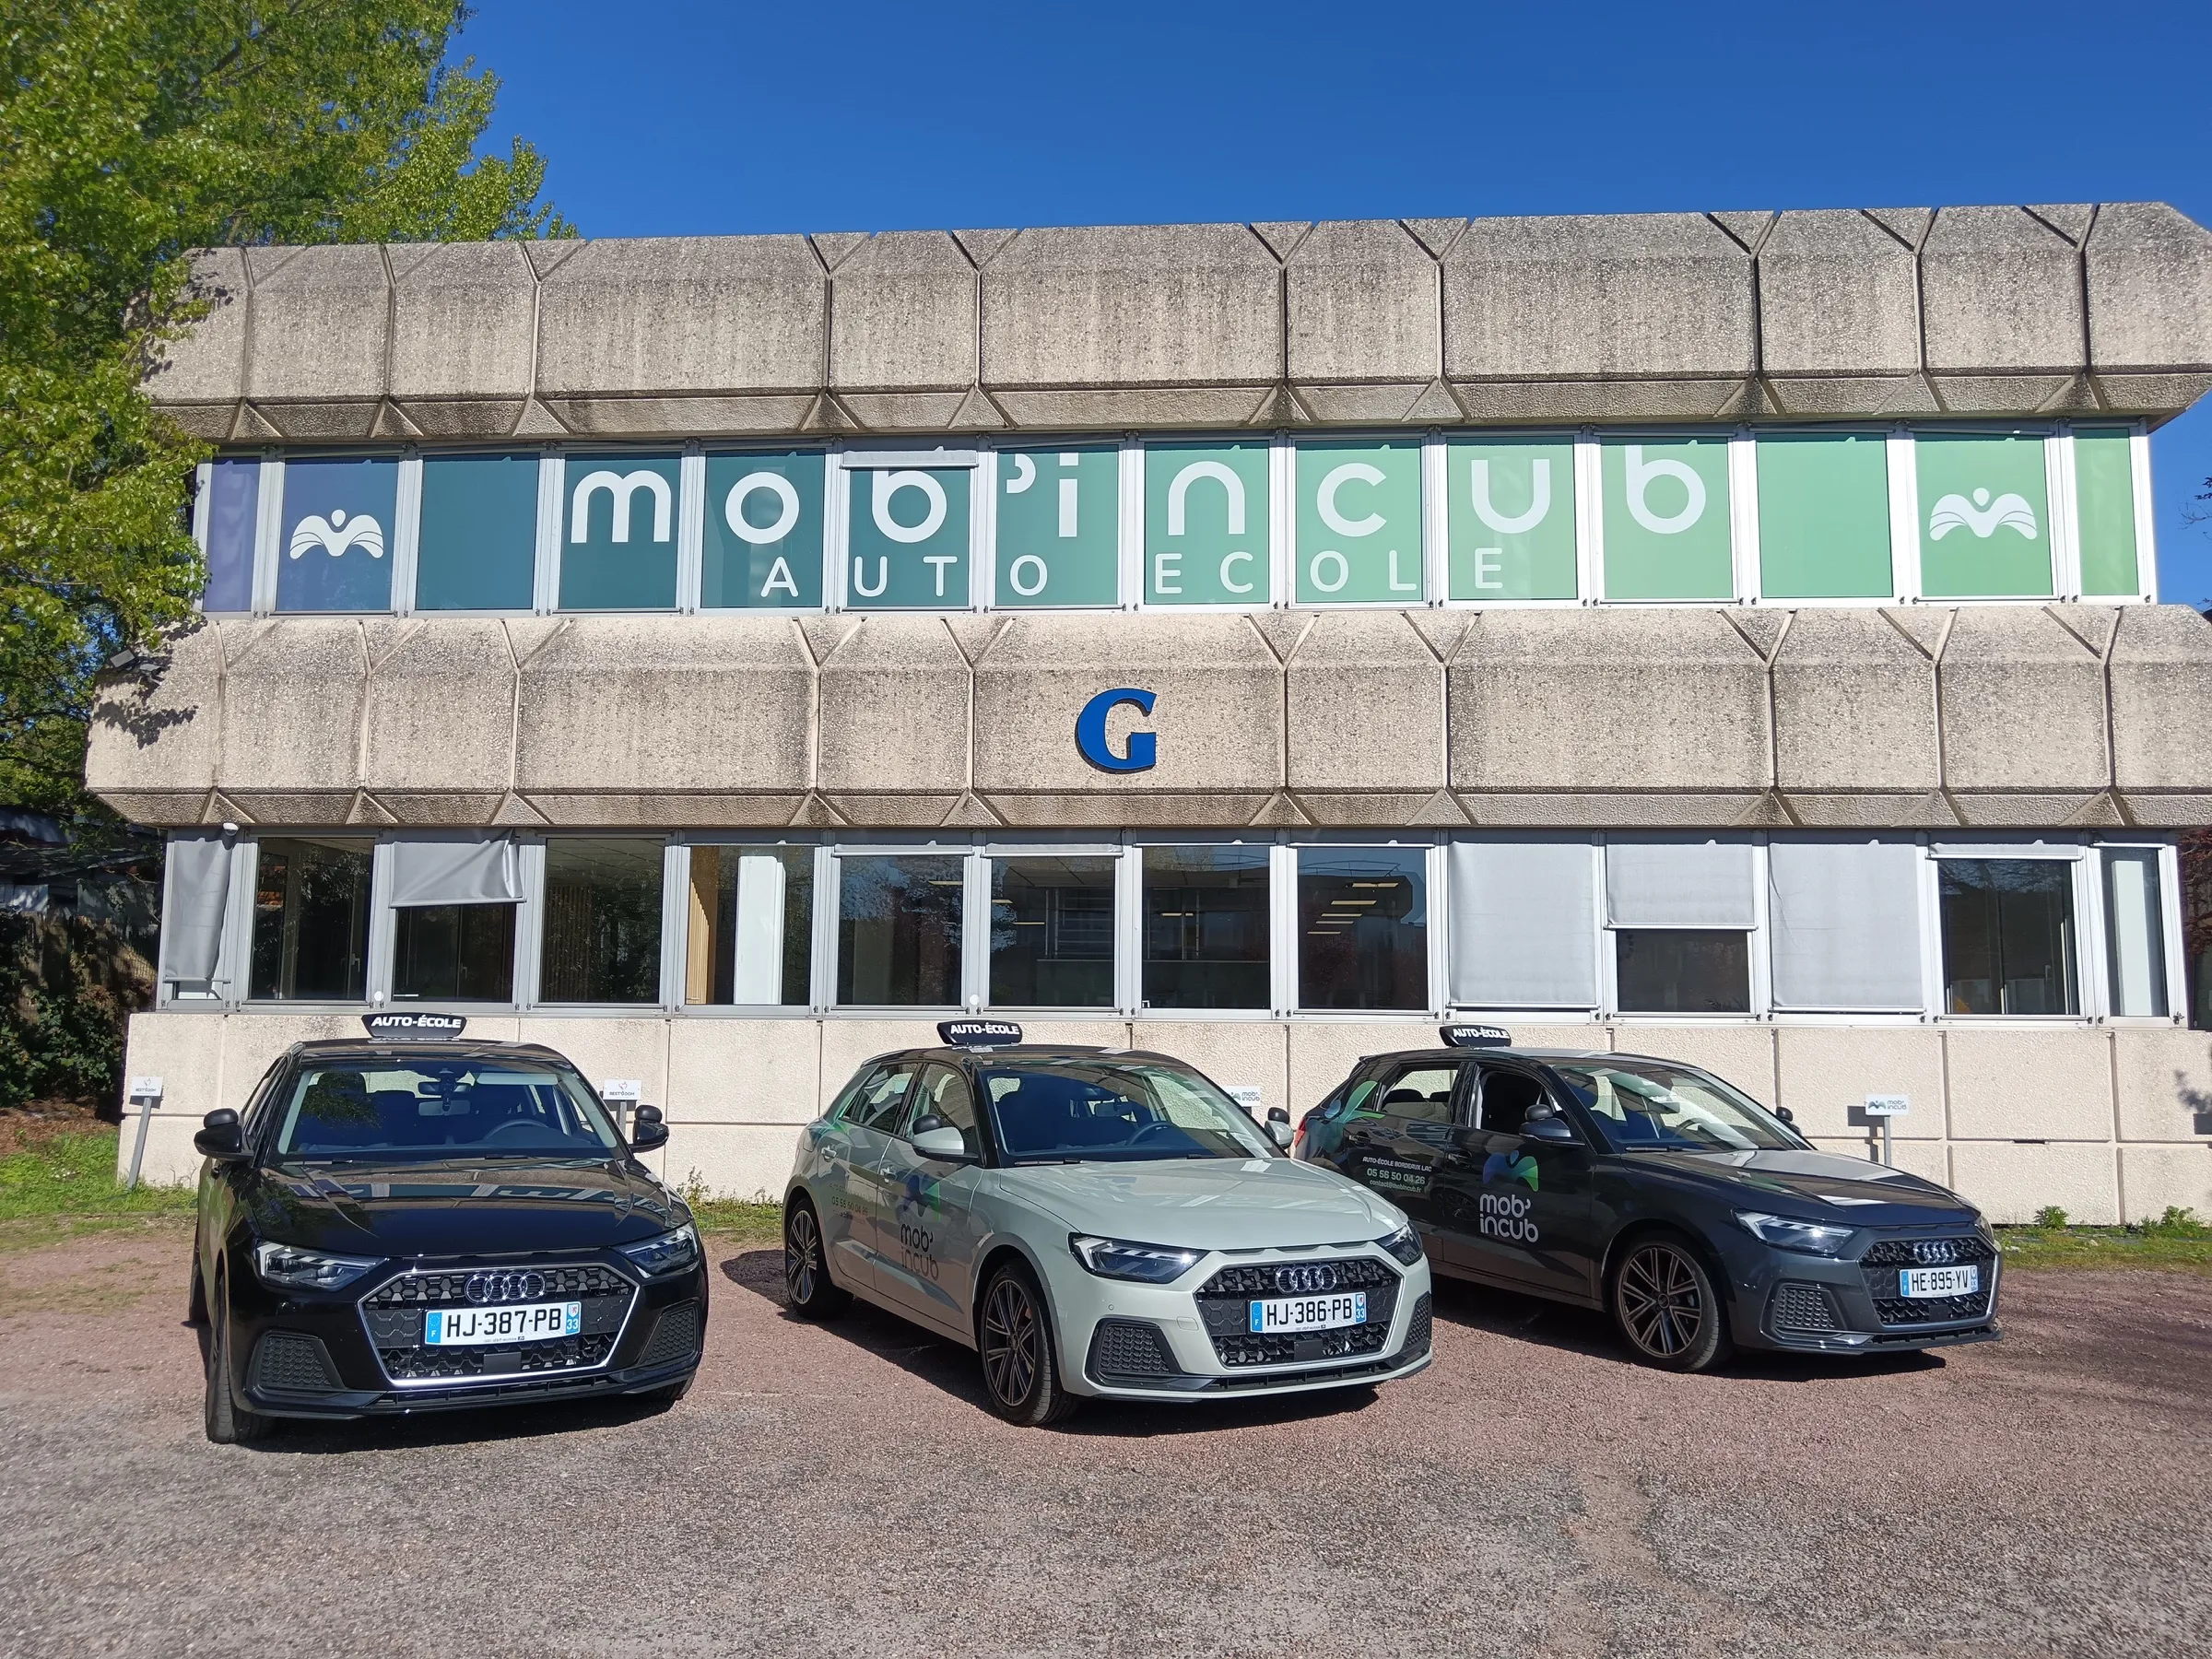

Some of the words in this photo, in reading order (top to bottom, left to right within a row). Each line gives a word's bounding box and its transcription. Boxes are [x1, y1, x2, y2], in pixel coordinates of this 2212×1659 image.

[759, 554, 1048, 597] AUTO
[1154, 547, 1503, 595] ECOLE
[1075, 687, 1158, 772] G
[371, 1014, 462, 1029] AUTO-ÉCOLE
[950, 1022, 1020, 1035] AUTO-ÉCOLE
[1453, 1027, 1511, 1040] AUTO-ÉCOLE
[1362, 1156, 1394, 1167] AUTO-ÉCOLE
[1394, 1160, 1421, 1171] BORDEAUX
[1421, 1164, 1433, 1172] LAC
[1366, 1168, 1378, 1177] 05
[1379, 1170, 1390, 1179] 56
[1391, 1171, 1402, 1181] 50
[1415, 1175, 1426, 1185] 26
[1479, 1193, 1532, 1218] mob'
[900, 1223, 935, 1253] mob'
[1479, 1213, 1539, 1243] incub
[900, 1245, 939, 1281] incub
[1911, 1269, 1969, 1292] HE-895-YV
[446, 1308, 561, 1338] HJ-387-PB
[566, 1318, 580, 1331] 33
[1266, 1298, 1352, 1326] HJ-386-PB
[1356, 1308, 1365, 1319] 33
